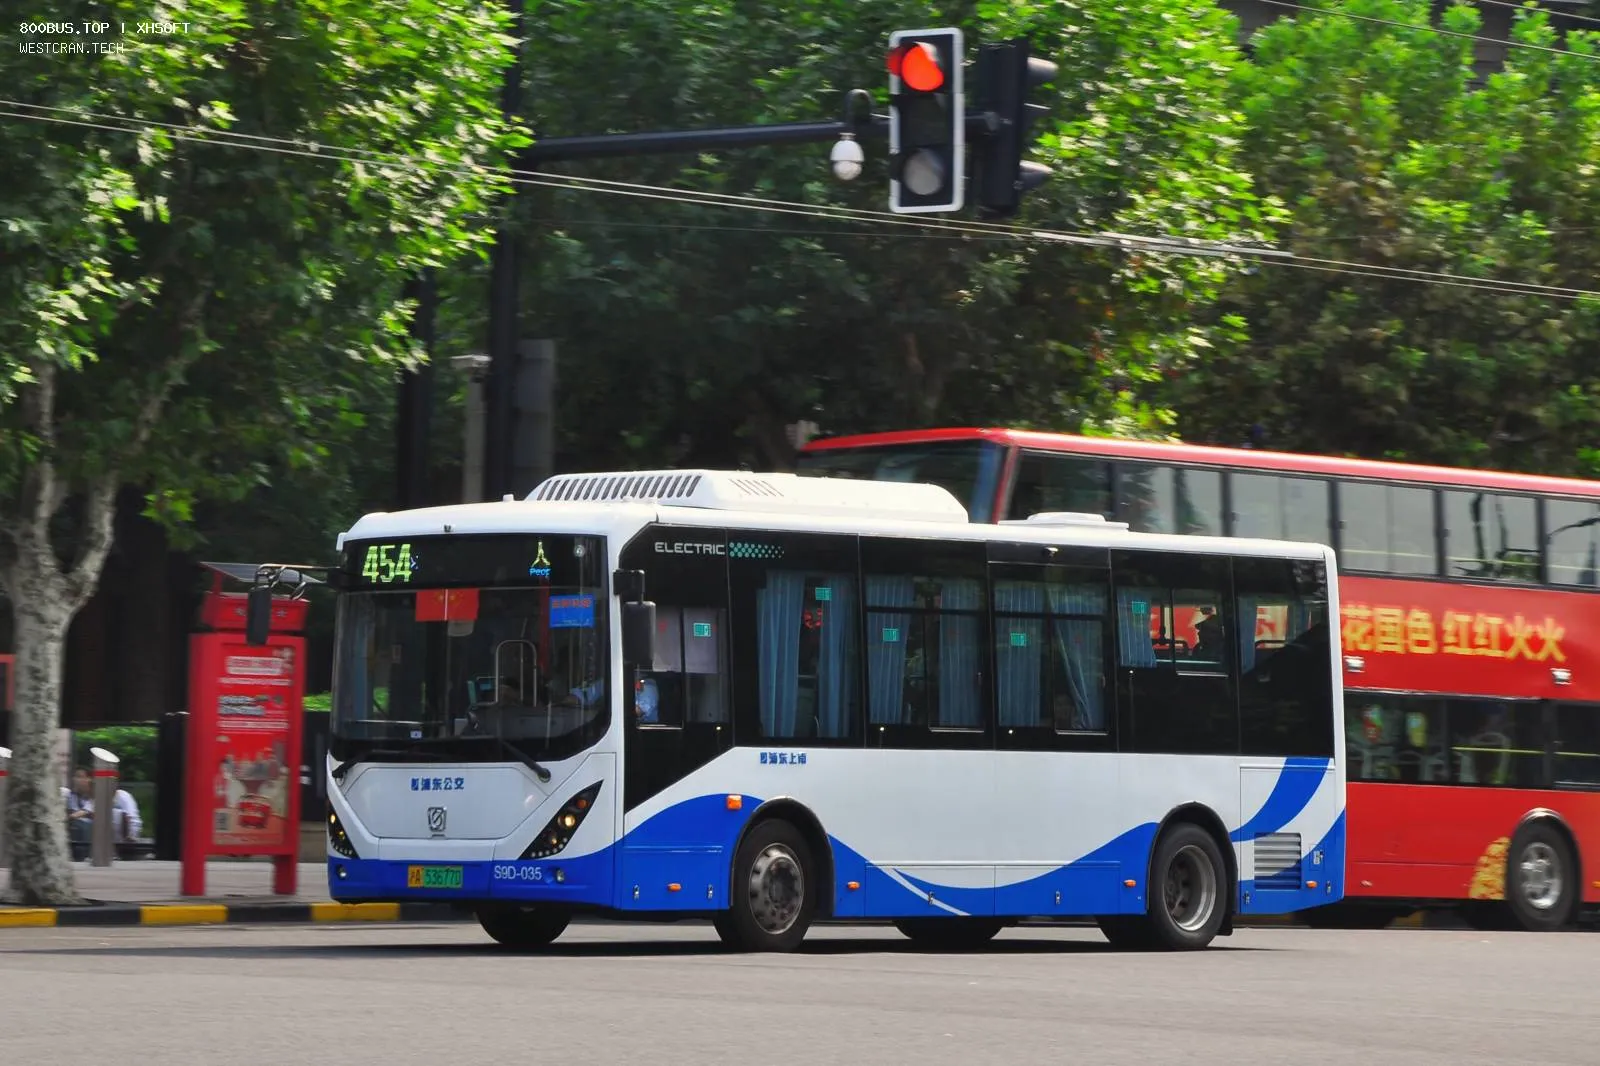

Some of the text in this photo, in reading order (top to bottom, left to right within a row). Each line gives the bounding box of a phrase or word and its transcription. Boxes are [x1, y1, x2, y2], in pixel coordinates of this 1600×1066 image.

[654, 541, 726, 556] ELECTRIC
[362, 543, 412, 583] 454
[1443, 609, 1567, 662] 红红火火
[493, 865, 543, 881] S9D-035
